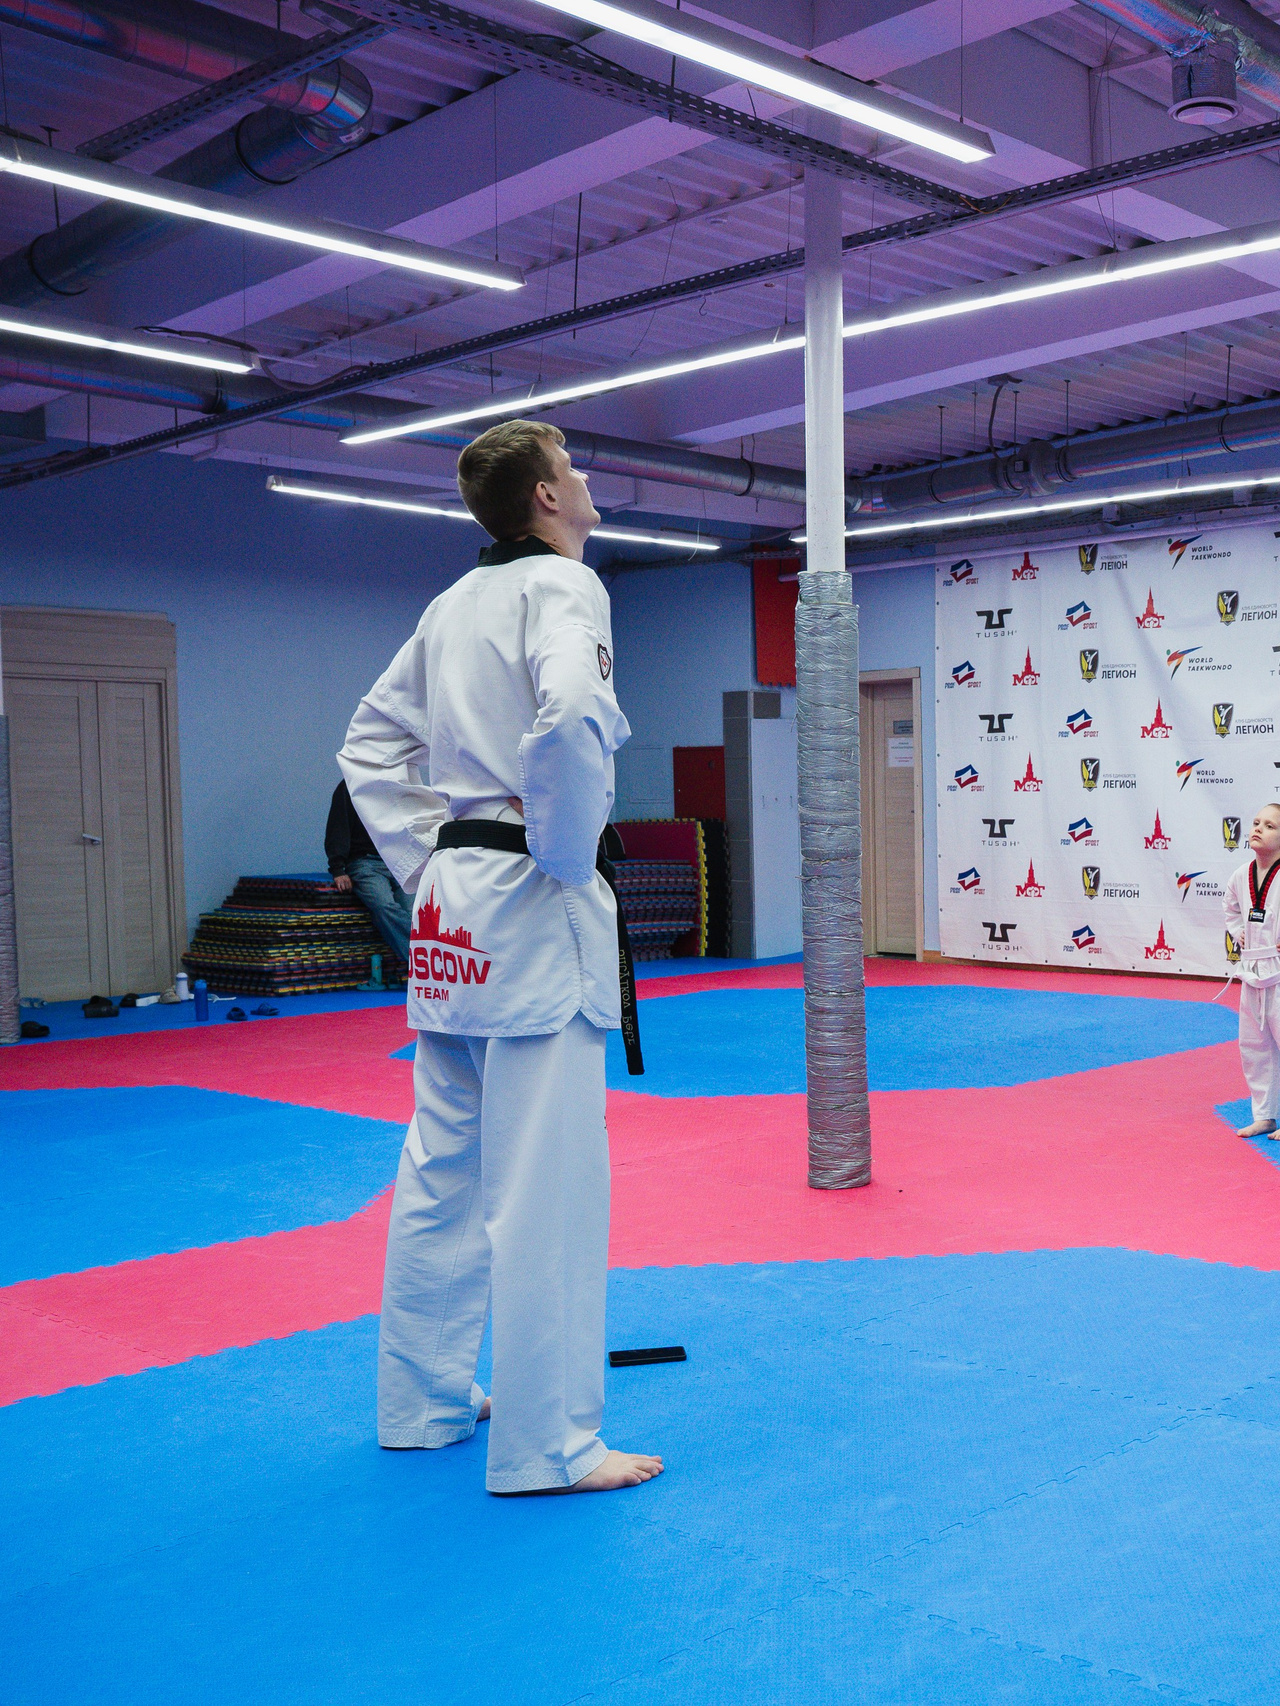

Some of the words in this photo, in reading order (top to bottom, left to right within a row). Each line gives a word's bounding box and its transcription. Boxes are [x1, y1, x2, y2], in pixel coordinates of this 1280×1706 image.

[1191, 552, 1231, 560] TAEKWONDO
[1241, 610, 1277, 622] ЛЕГИОН
[1102, 670, 1136, 679] ЛЕГИОН
[1235, 724, 1274, 734] ЛЕГИОН
[1103, 780, 1136, 788] ЛЕГИОН
[1103, 889, 1139, 898] ЛЕГИОН
[408, 947, 491, 984] SCOW
[415, 986, 449, 1001] TEAM
